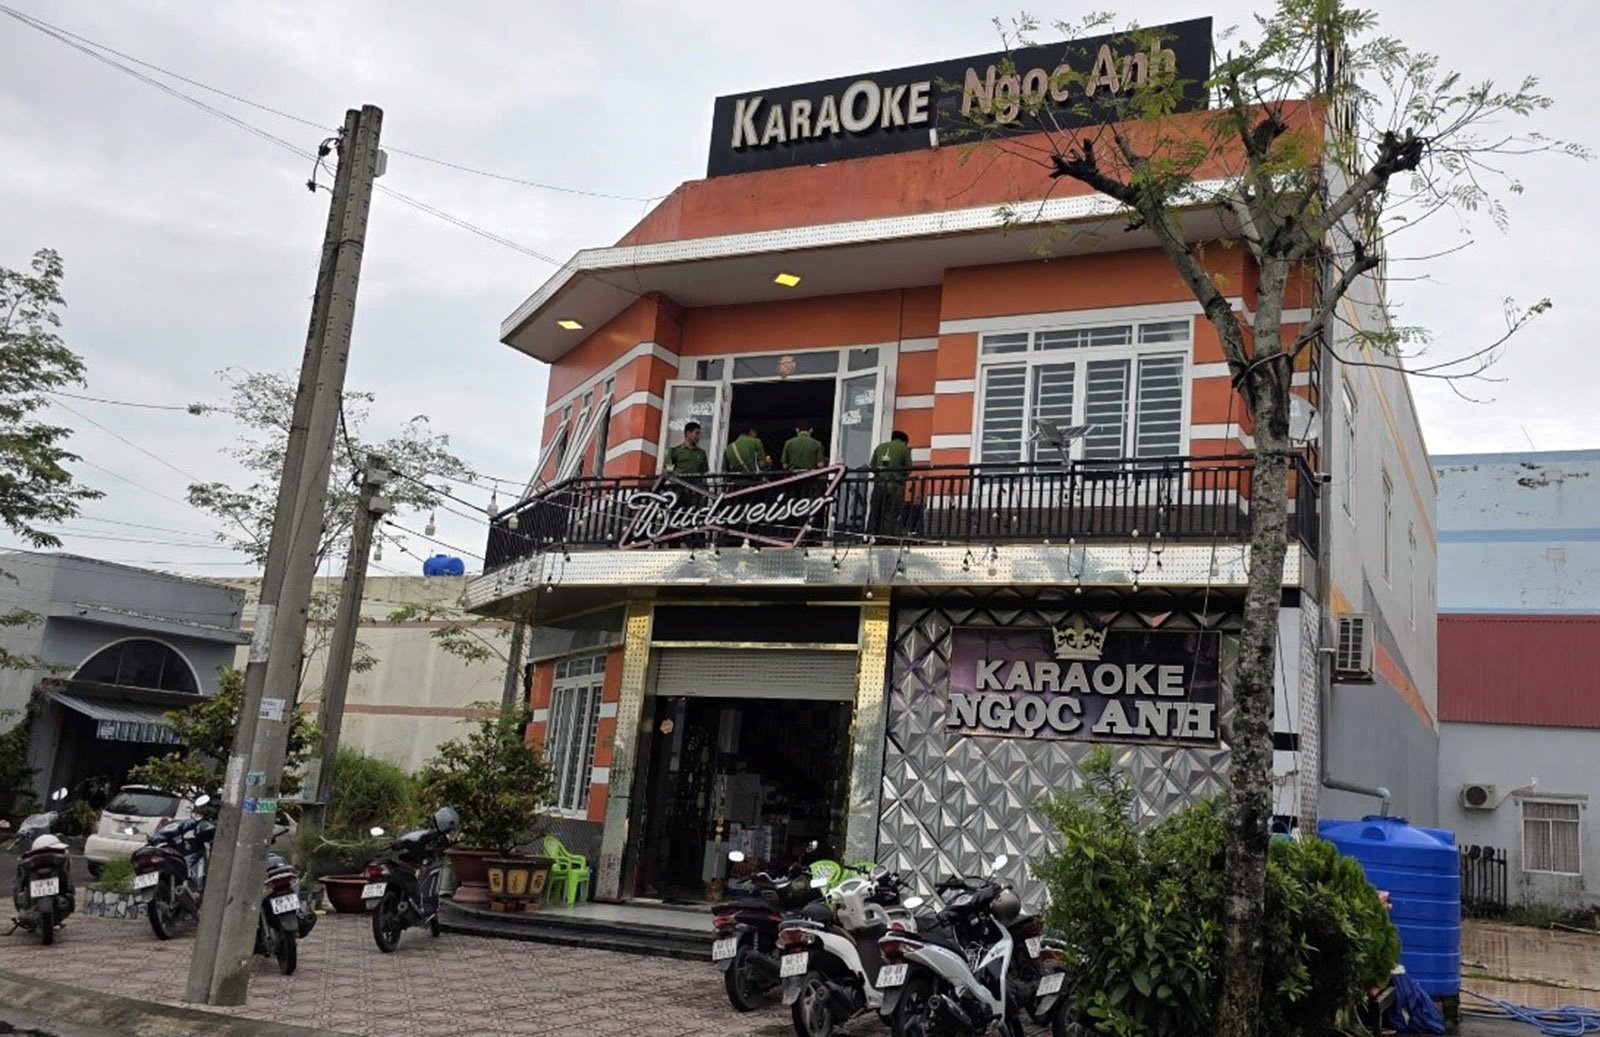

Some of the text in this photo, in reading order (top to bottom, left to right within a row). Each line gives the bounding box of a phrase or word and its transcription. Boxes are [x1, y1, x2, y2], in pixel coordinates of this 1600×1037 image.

[732, 80, 931, 149] KARAOKE
[1086, 37, 1177, 97] Anh
[627, 491, 834, 538] Budweiser
[975, 659, 1185, 696] KARAOKE
[946, 692, 1217, 739] NGỌC ANH
